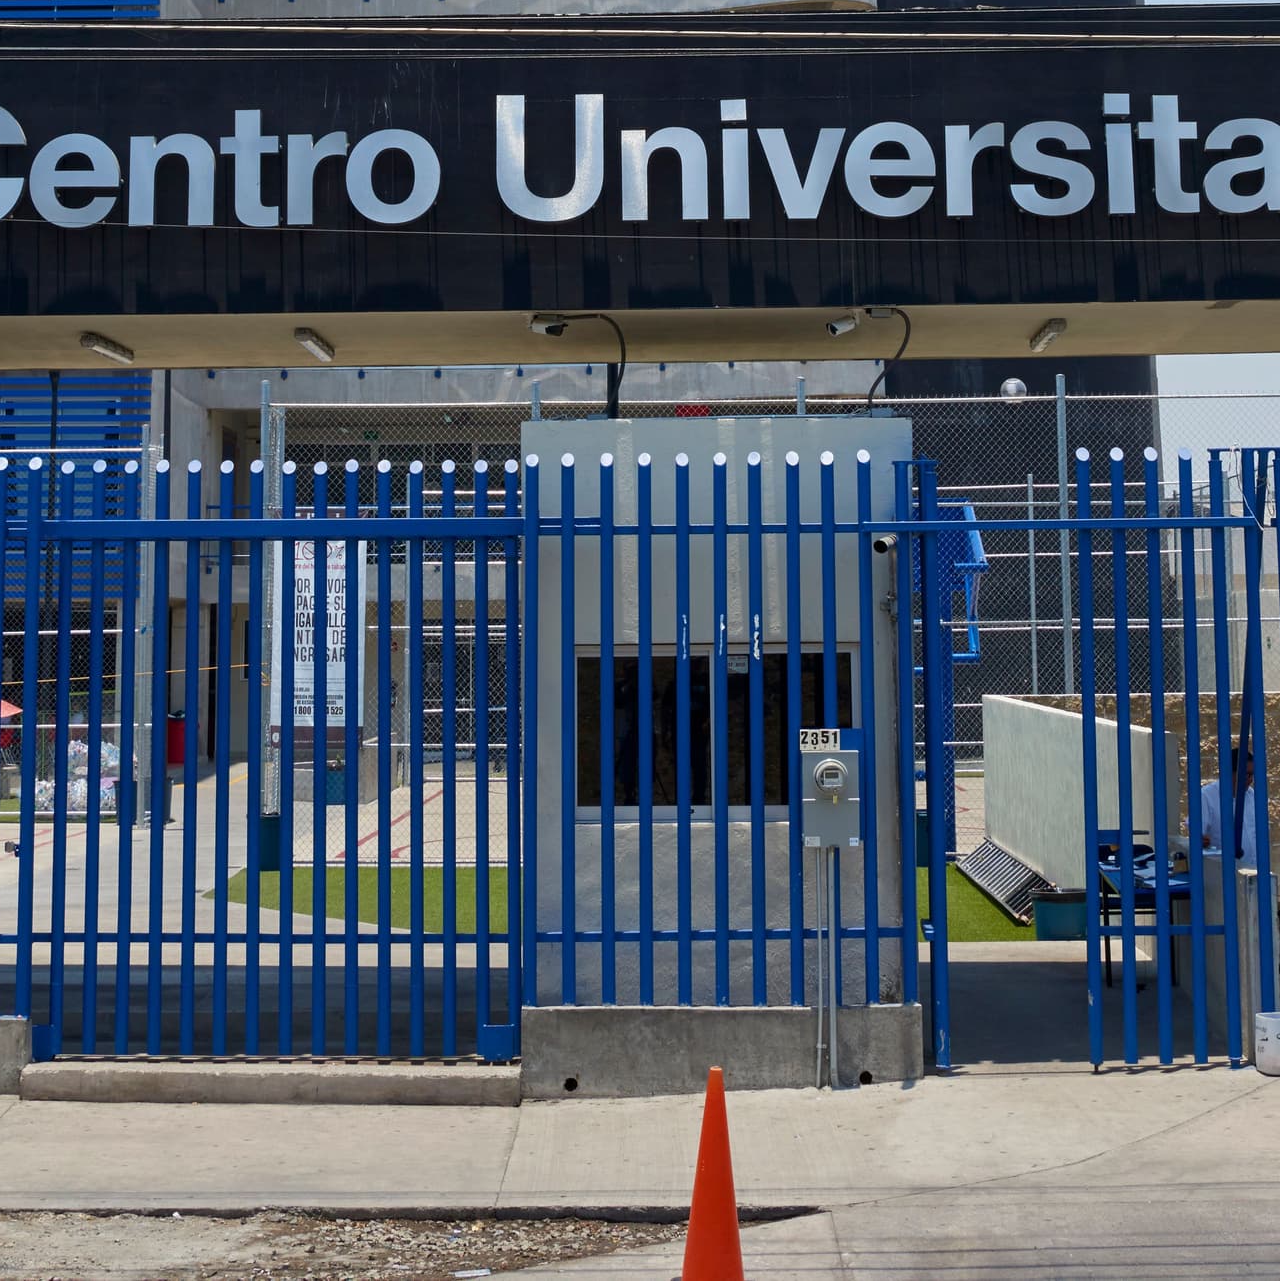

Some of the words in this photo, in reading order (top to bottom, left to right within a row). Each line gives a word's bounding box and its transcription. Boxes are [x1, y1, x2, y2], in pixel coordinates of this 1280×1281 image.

[292, 578, 311, 593] OR
[298, 706, 312, 715] 800
[331, 706, 344, 716] 525
[801, 731, 838, 746] 2351
